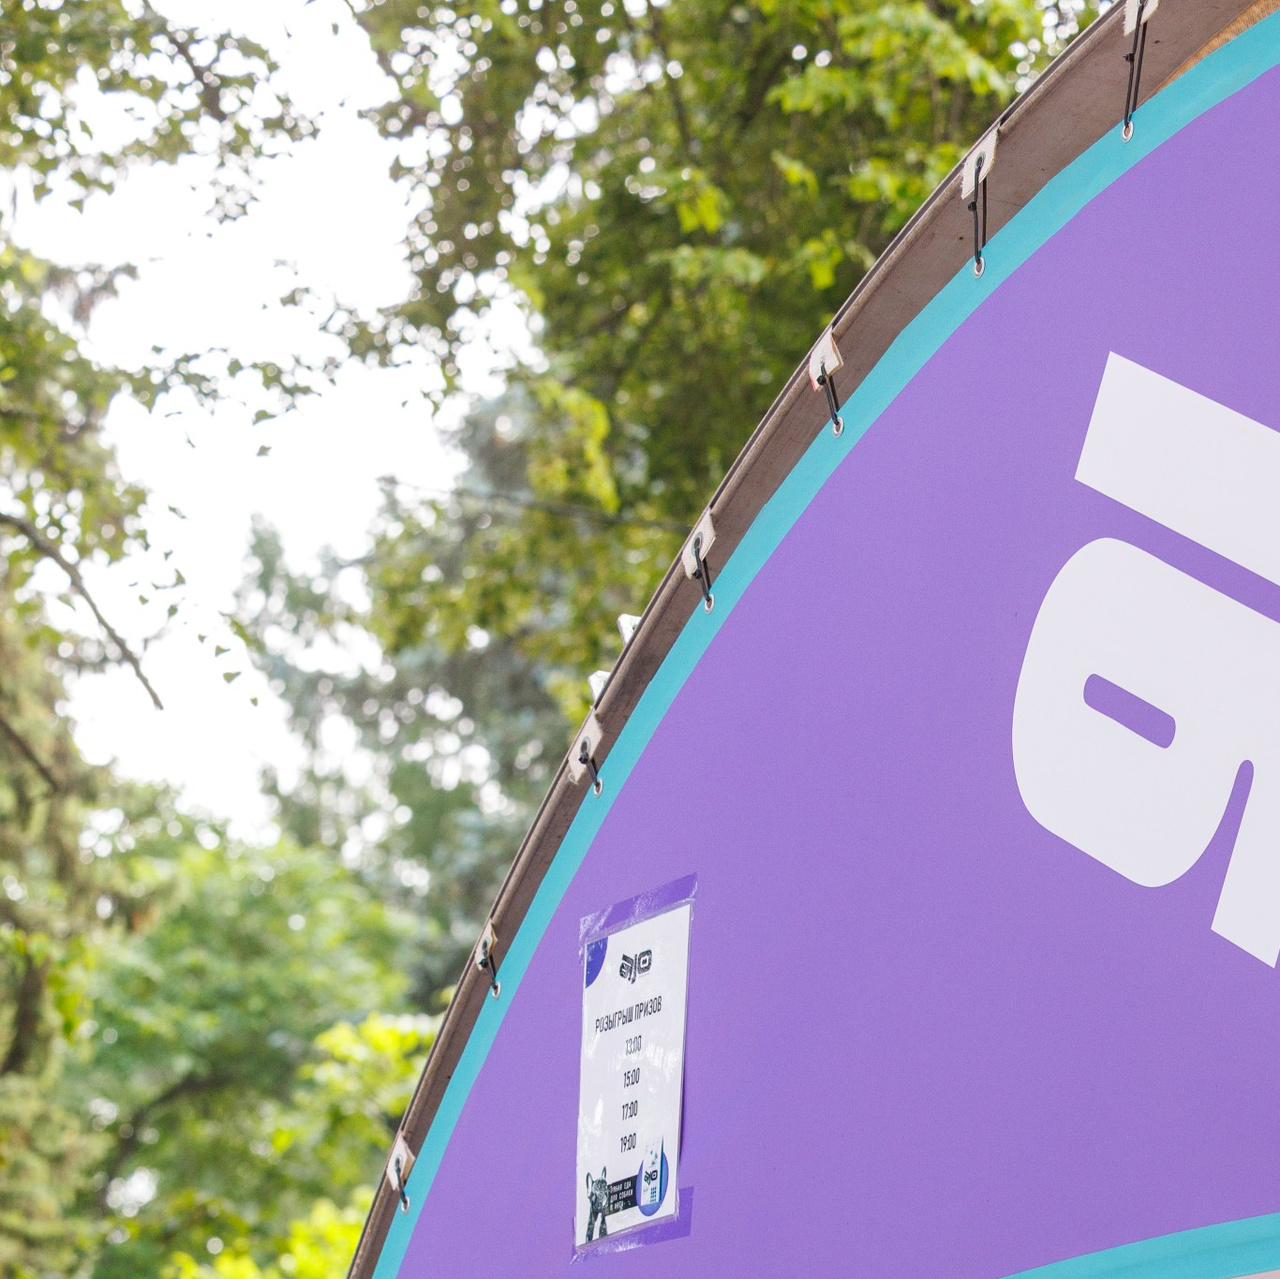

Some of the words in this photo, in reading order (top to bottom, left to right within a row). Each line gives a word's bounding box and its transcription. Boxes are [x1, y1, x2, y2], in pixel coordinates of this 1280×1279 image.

[595, 1006, 635, 1033] РОЗЫГРЫШ
[635, 995, 662, 1020] ПРИЗОВ
[625, 1035, 642, 1055] 13:00
[623, 1067, 640, 1089] 15:00
[621, 1100, 638, 1121] 17:00
[620, 1132, 637, 1153] 19:00
